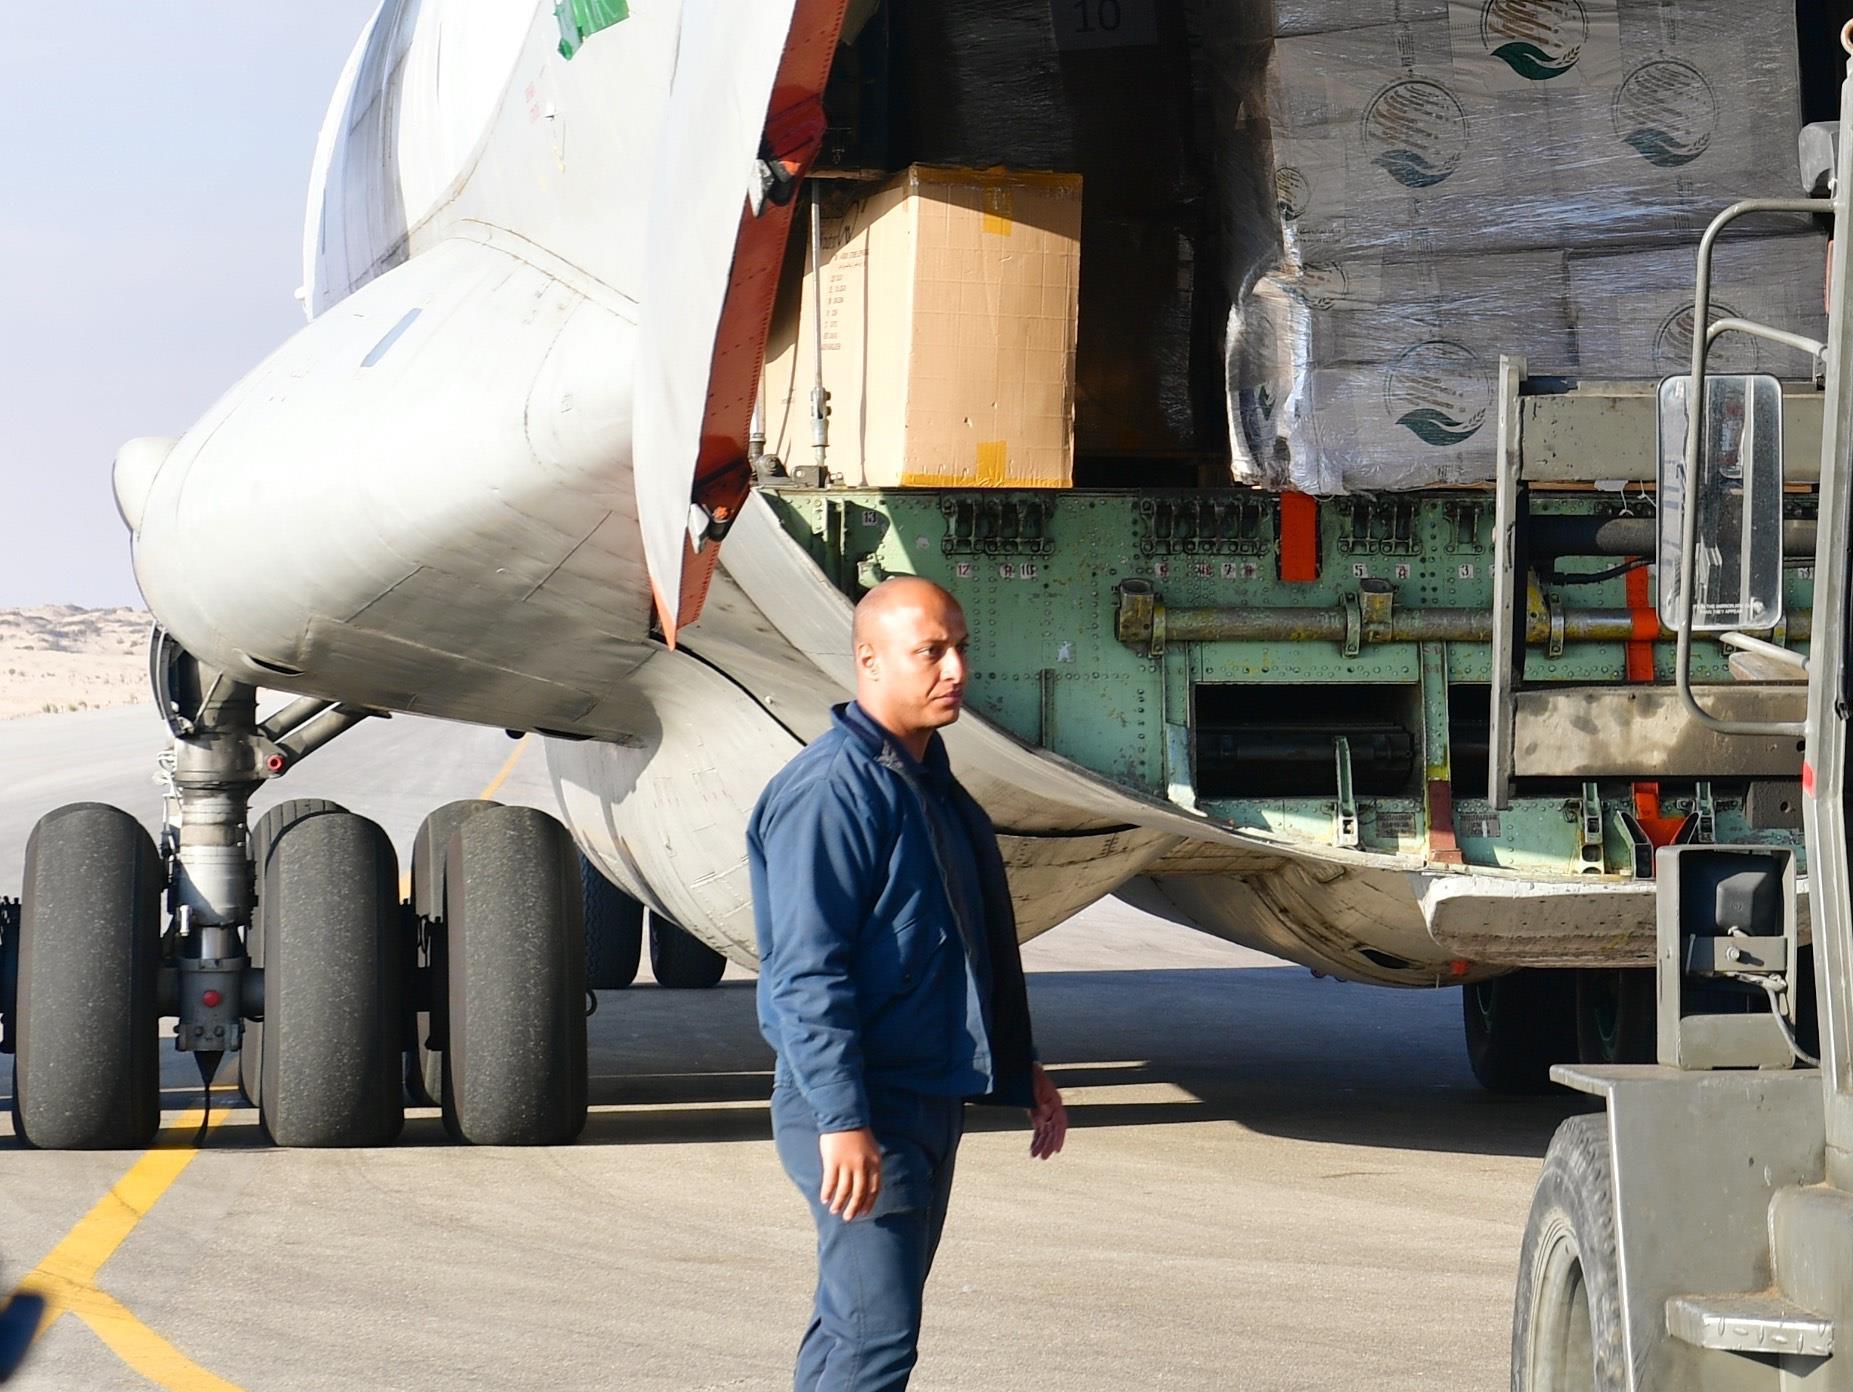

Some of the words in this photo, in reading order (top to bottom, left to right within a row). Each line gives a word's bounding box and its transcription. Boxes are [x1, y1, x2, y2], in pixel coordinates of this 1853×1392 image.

[864, 512, 877, 523] 13
[1224, 564, 1231, 575] 7
[1355, 565, 1363, 576] 5
[1461, 564, 1469, 576] 3
